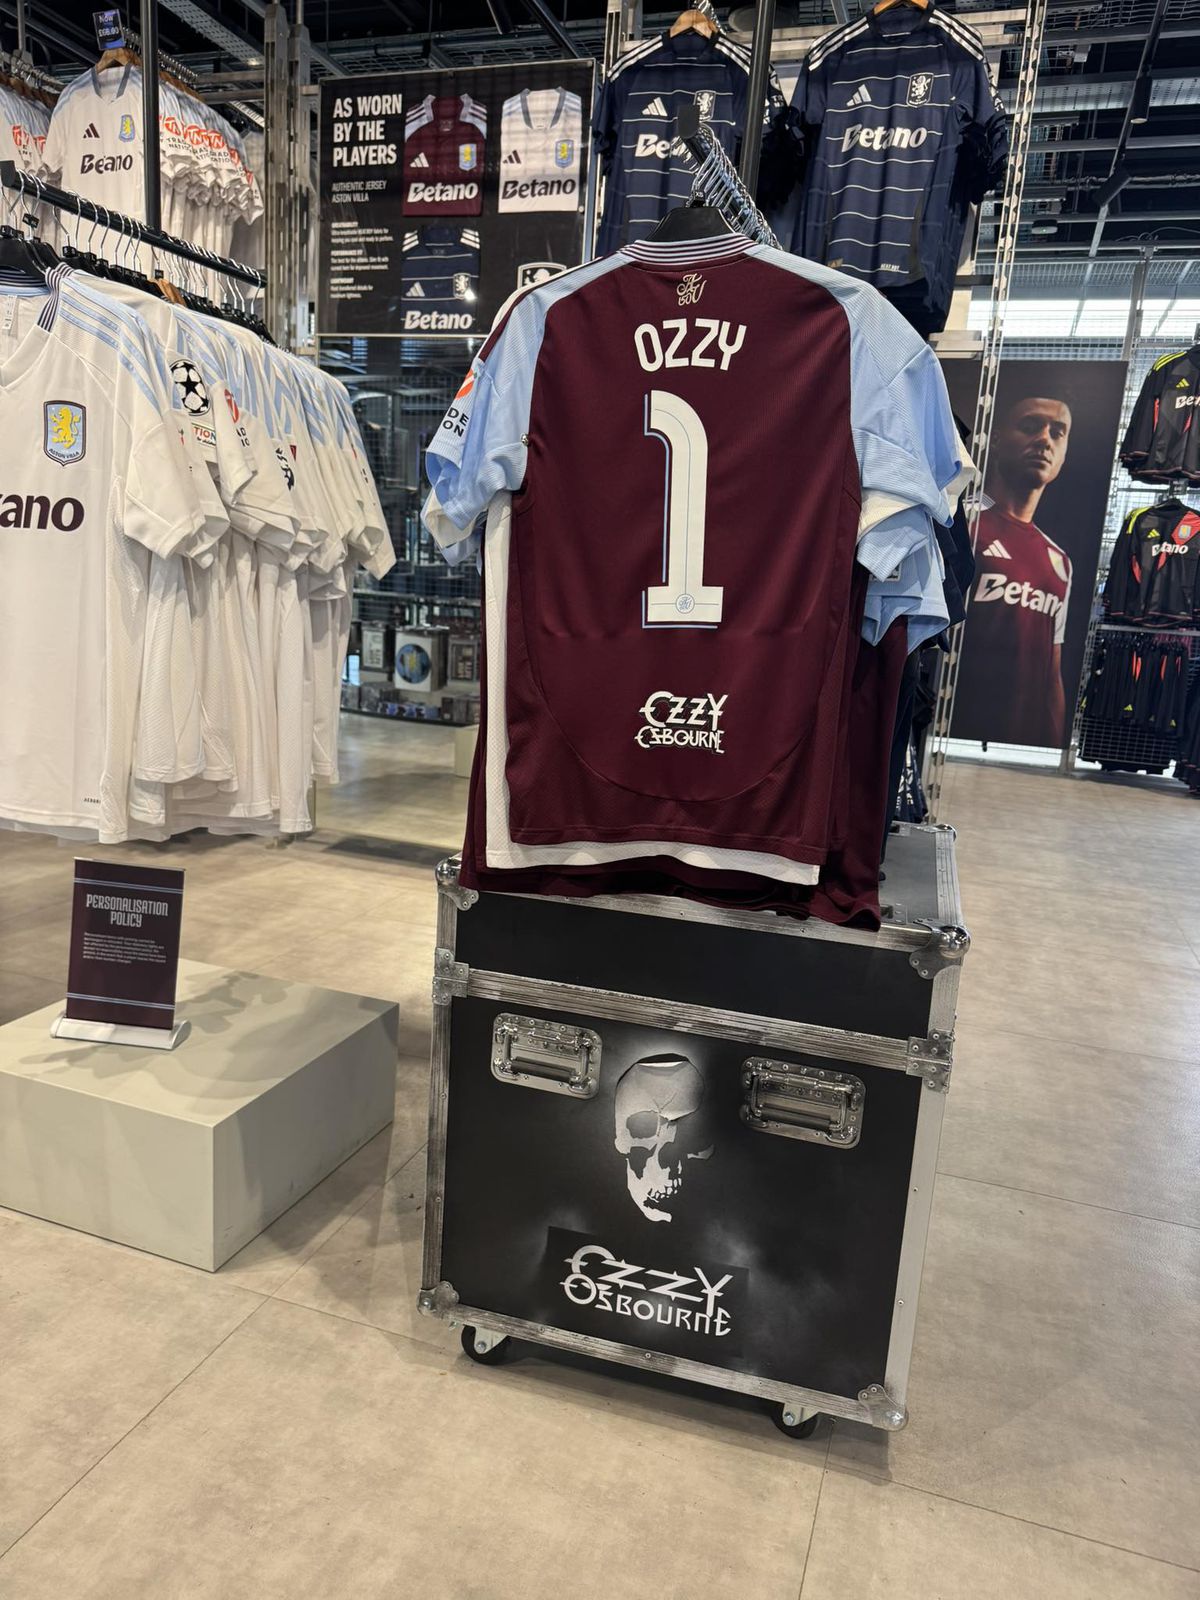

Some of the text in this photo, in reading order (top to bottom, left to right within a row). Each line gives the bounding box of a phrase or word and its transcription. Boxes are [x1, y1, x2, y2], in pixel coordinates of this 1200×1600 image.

[333, 93, 402, 118] AS WORN
[333, 120, 385, 142] BY THE
[842, 124, 927, 152] Betano
[333, 144, 397, 167] PLAYERS
[332, 180, 387, 191] AUTHENTIC JERSEY
[332, 192, 369, 203] ASTON VILLA
[407, 182, 478, 202] Betano
[501, 179, 576, 199] Betano
[404, 310, 473, 329] Betano
[634, 318, 747, 372] OZZY
[0, 494, 85, 532] ano
[643, 389, 723, 629] 1
[639, 691, 729, 732] OZZY
[634, 725, 725, 754] OSBOURNE
[86, 893, 168, 916] PERSONALISATION
[110, 911, 142, 928] POLICY
[564, 1244, 734, 1318] OZZY
[559, 1273, 732, 1337] OSBOURNE
